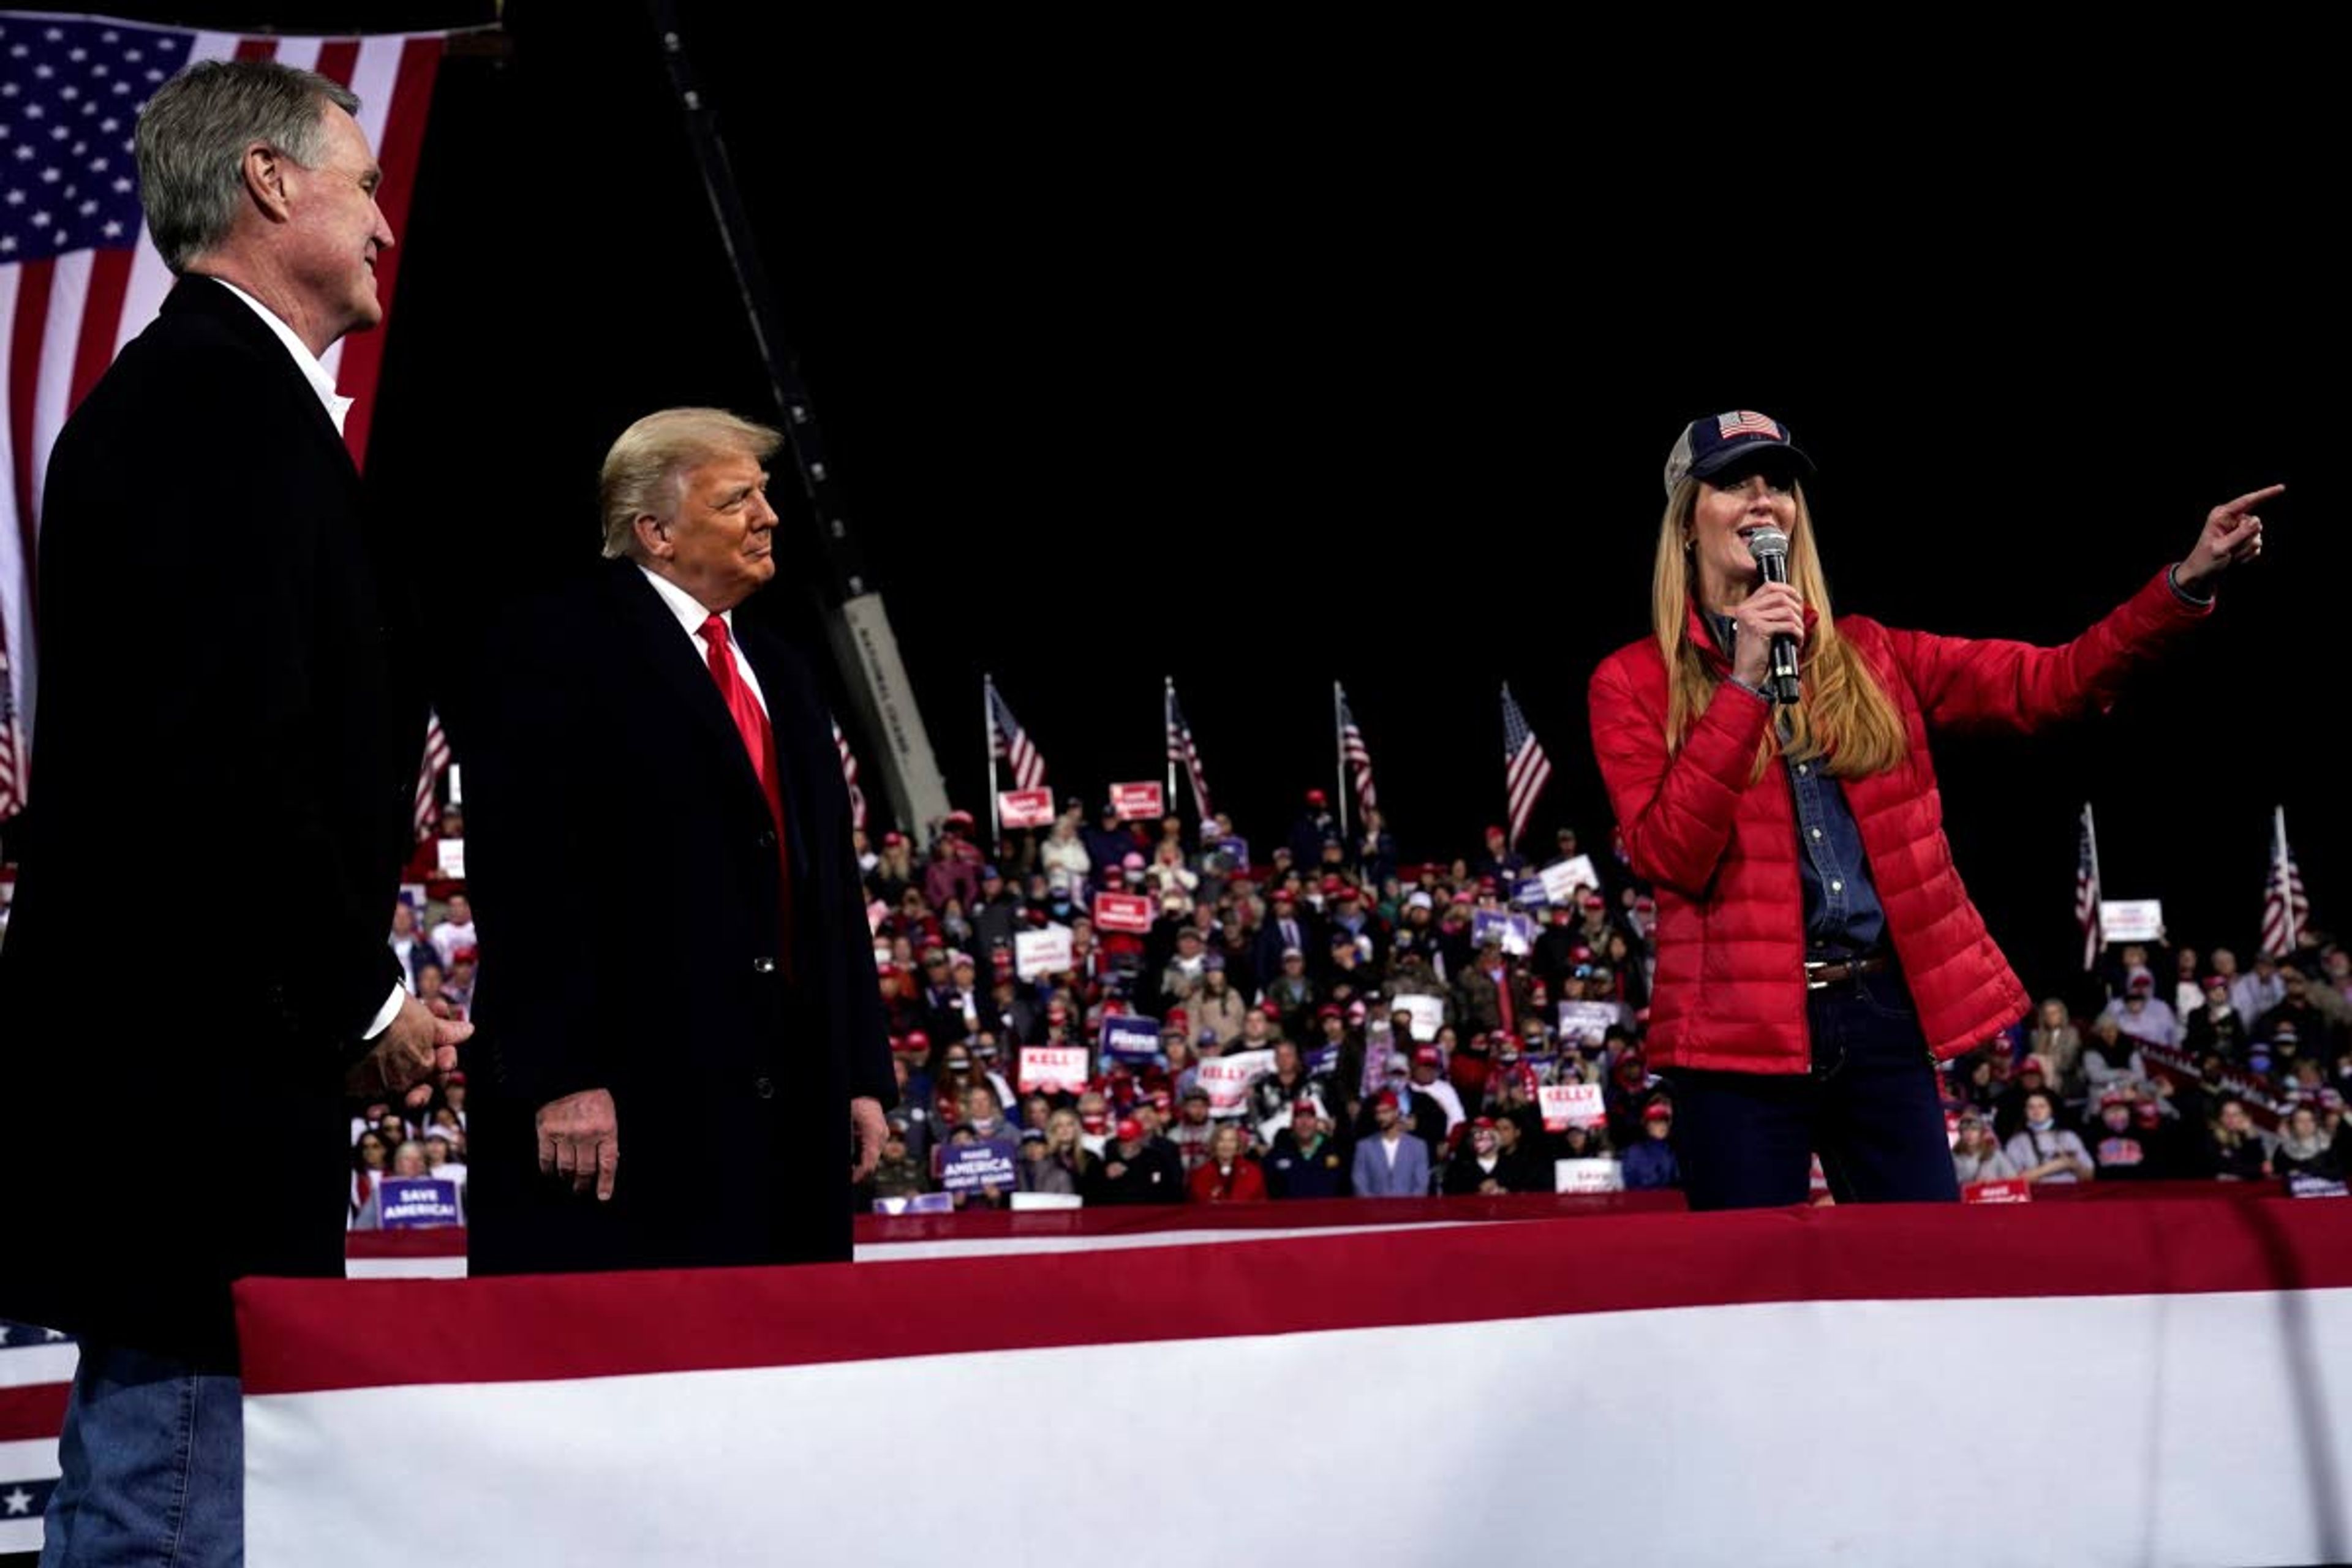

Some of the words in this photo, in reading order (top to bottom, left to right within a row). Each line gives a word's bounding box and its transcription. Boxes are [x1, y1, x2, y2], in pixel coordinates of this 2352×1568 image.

[1028, 1054, 1083, 1066] KELL
[944, 1157, 1012, 1175] AMERICA
[400, 1189, 439, 1202] SAVE
[384, 1204, 455, 1218] AMERICA!
